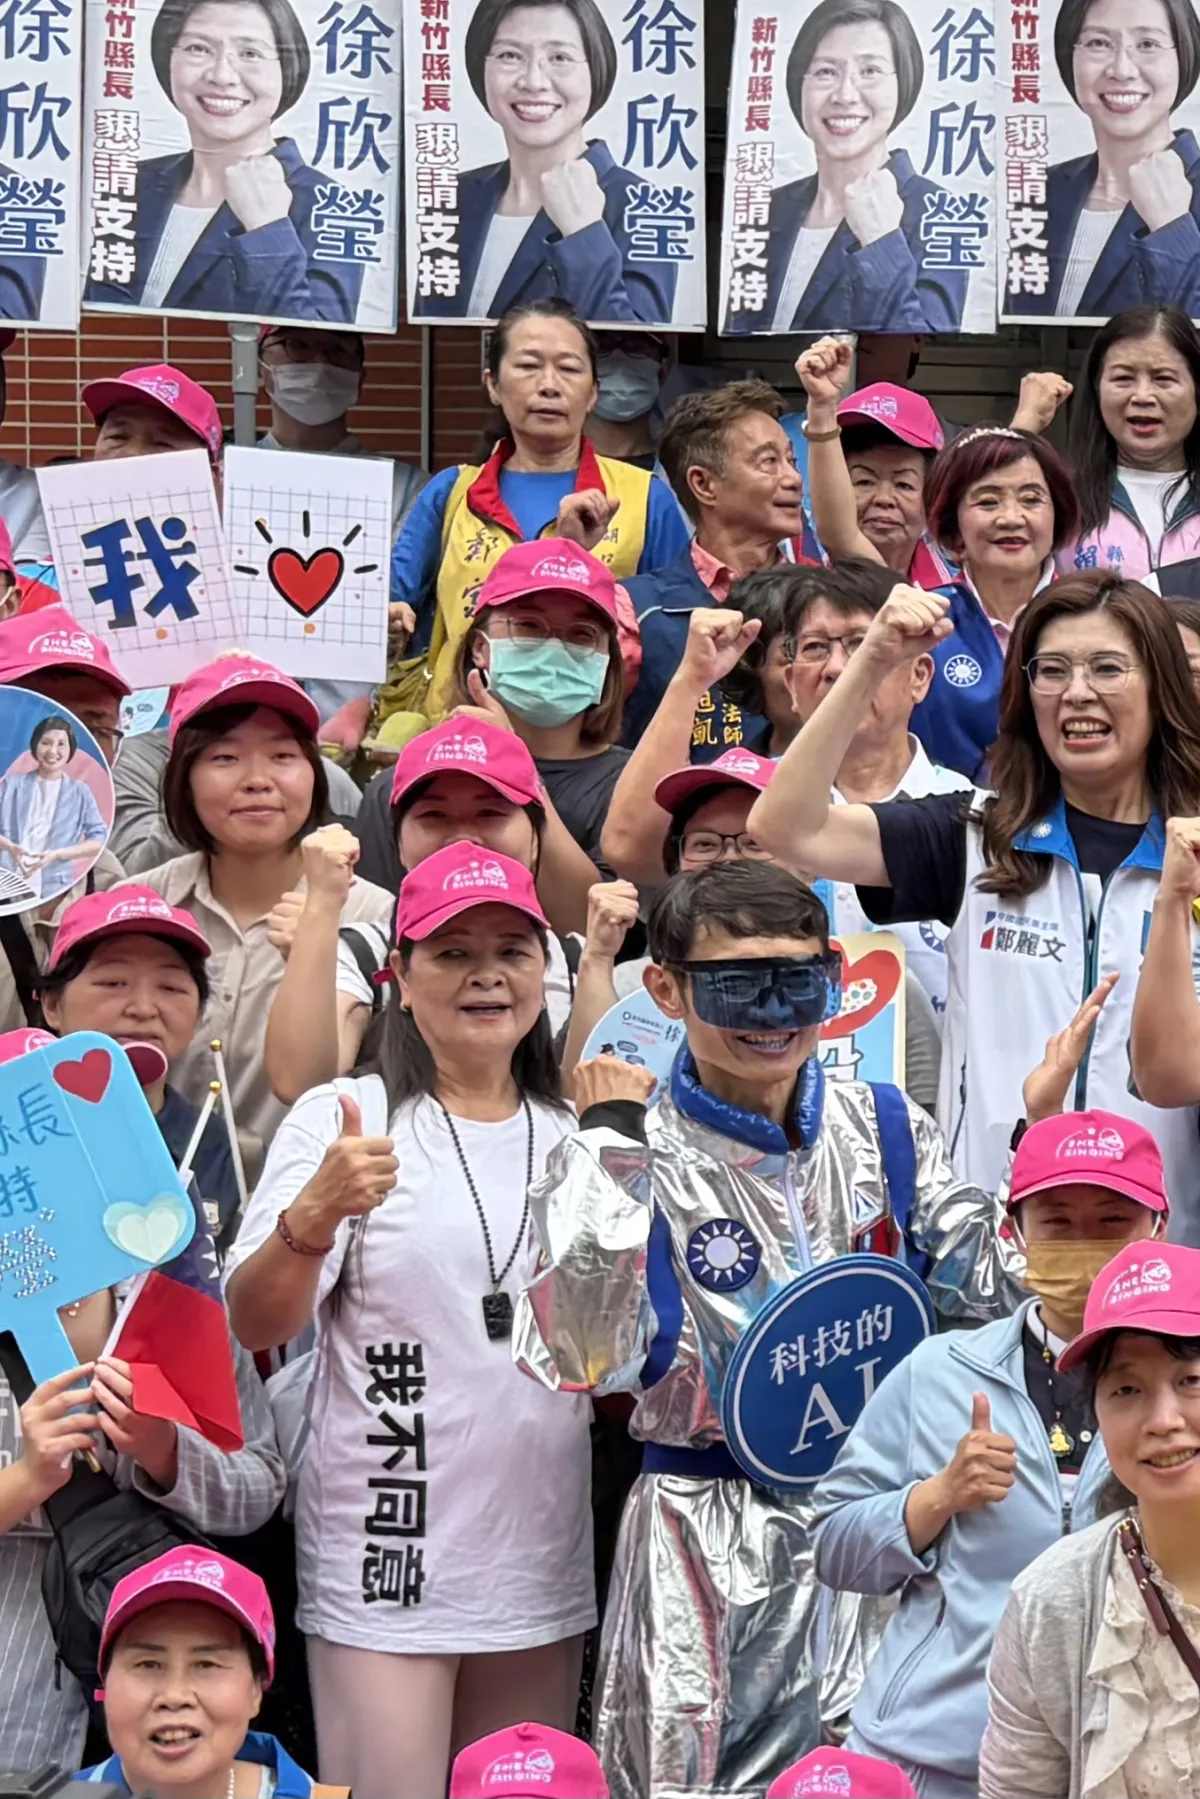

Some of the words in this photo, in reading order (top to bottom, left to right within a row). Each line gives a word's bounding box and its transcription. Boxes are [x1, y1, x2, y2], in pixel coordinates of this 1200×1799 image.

[0, 0, 73, 257] 徐欣瑩
[103, 0, 137, 101] 竹縣長
[309, 1, 396, 264] 徐欣瑩
[420, 0, 452, 113] 新竹縣長
[621, 0, 699, 263] 徐欣瑩
[744, 17, 778, 133] 新竹縣長
[1011, 0, 1041, 105] 竹縣長
[90, 108, 141, 285] 懇請支持
[415, 122, 461, 298] 懇請支持
[920, 7, 996, 271] 徐欣瑩
[1005, 114, 1050, 297] 懇請支持
[729, 141, 775, 313] 懇請支持
[80, 515, 202, 630] 我
[995, 926, 1068, 963] 鄭麗文
[768, 1303, 894, 1386] 科技的
[361, 1341, 427, 1608] 我不同意
